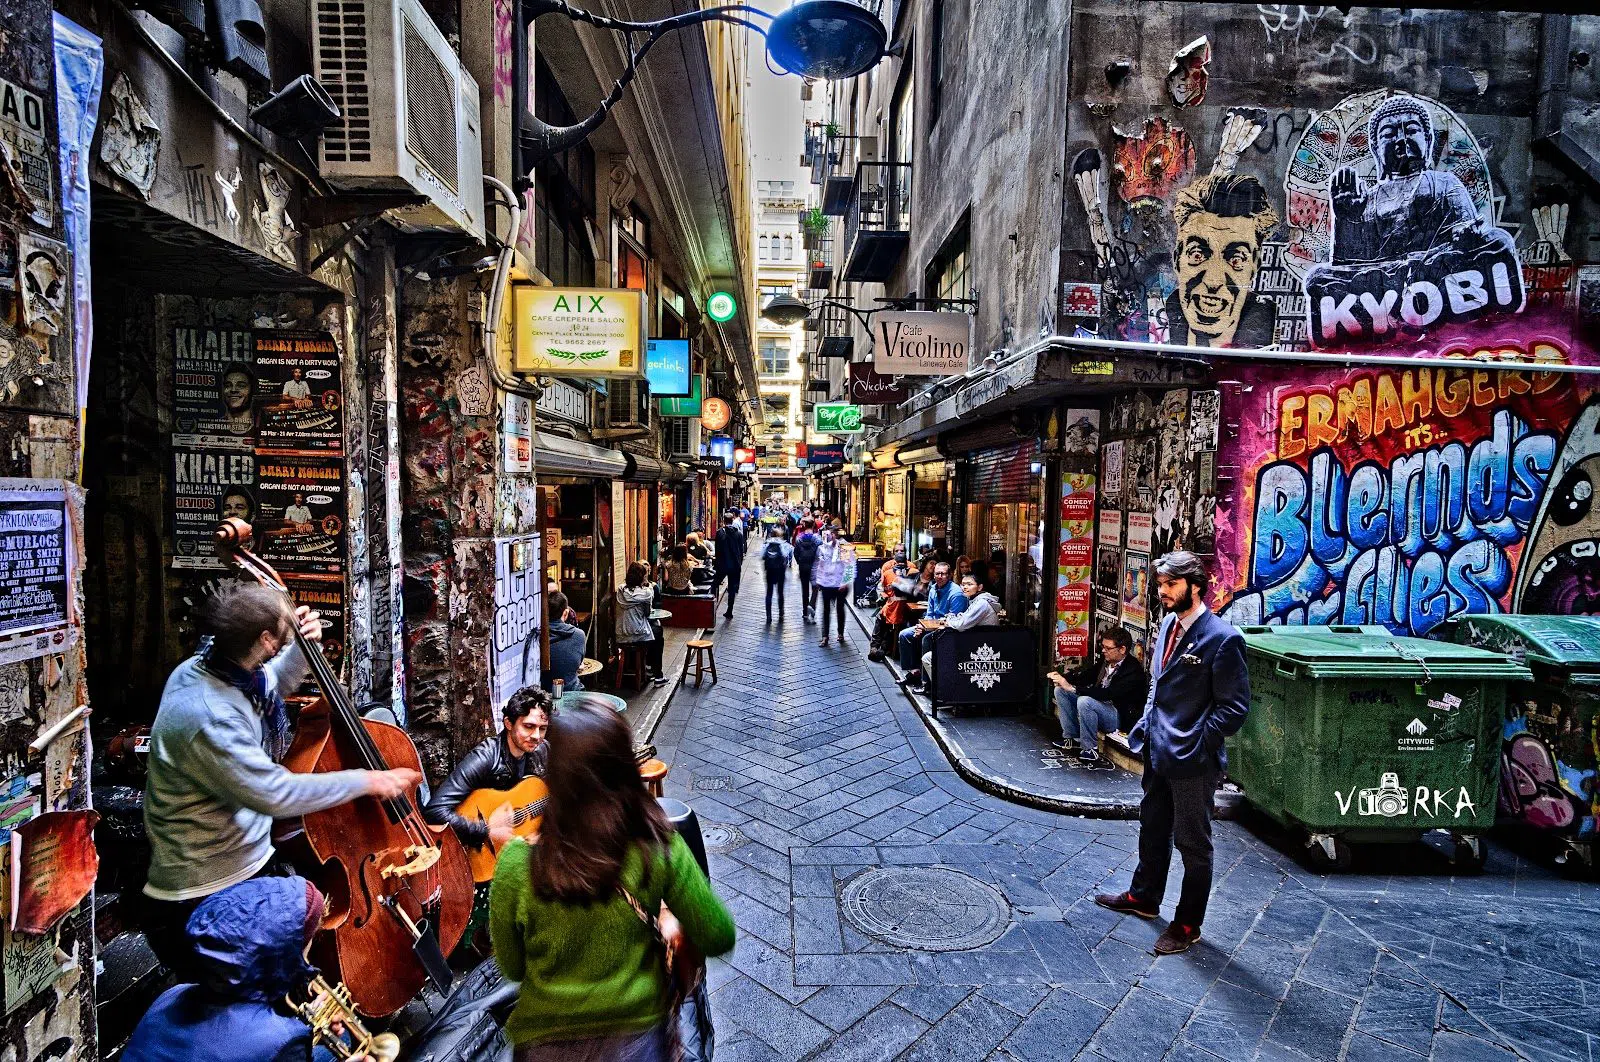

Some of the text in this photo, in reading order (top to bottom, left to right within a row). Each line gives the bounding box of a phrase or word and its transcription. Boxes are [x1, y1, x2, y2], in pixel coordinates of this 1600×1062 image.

[553, 295, 605, 313] AIX
[1320, 262, 1513, 339] KYOBI
[902, 324, 923, 336] Cafe
[880, 321, 964, 359] Vicolino
[256, 357, 278, 365] ORGAN
[919, 359, 963, 368] Laneway Cafe
[176, 373, 216, 386] DEVIOUS
[176, 389, 203, 398] TRADES
[1278, 345, 1567, 460] ERMAHGERD
[174, 452, 255, 485] KHALED
[259, 465, 341, 480] BARRY MORGAN
[260, 482, 281, 490] ORGAN
[176, 497, 215, 510] DEVIOUS
[175, 512, 219, 521] TRADES HALL
[6, 534, 59, 550] MURLOCS
[37, 548, 62, 558] SMITH
[16, 560, 35, 569] JUAN
[12, 567, 44, 578] SALESMEN
[299, 590, 341, 604] MORGAN
[957, 661, 1013, 671] SIGNATURE
